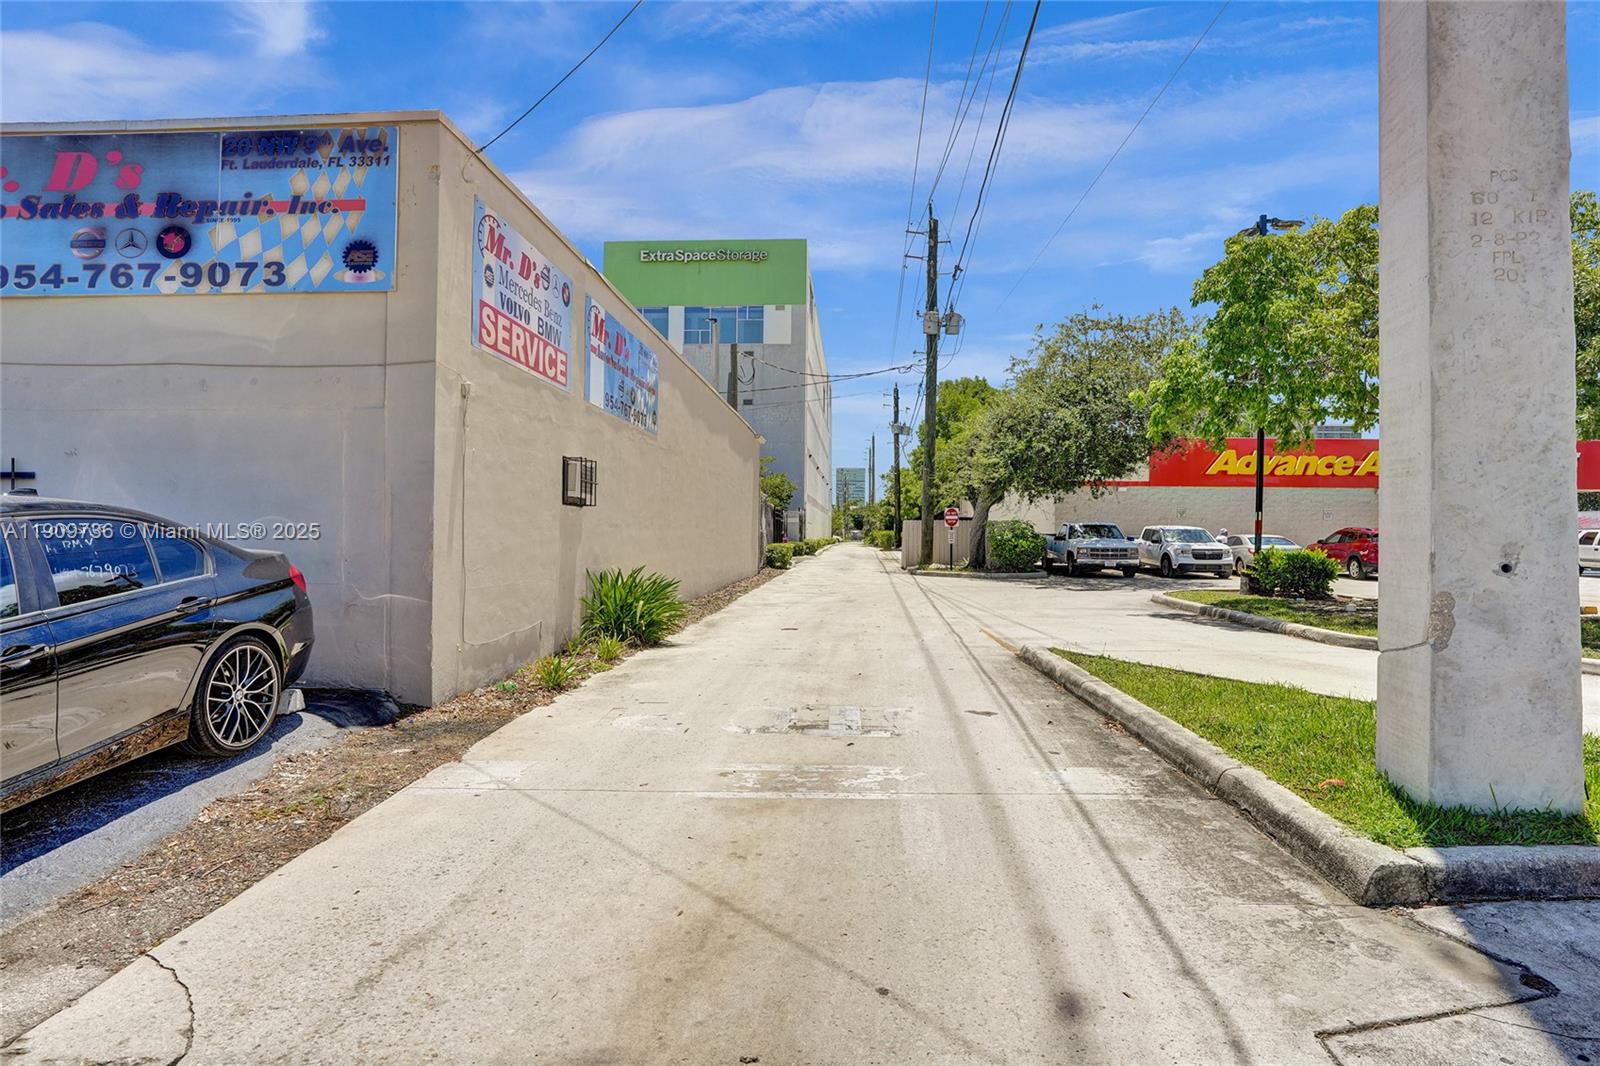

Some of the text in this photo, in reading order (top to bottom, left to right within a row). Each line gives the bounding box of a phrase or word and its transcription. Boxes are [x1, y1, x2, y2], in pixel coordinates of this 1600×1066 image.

[339, 135, 389, 153] Ave.
[42, 150, 144, 192] D's
[221, 155, 390, 170] Ft. Lauderdale, FL 33311
[1490, 169, 1519, 182] PCS
[17, 195, 105, 219] Sales
[115, 193, 143, 218] &
[288, 195, 339, 214] Inc.
[485, 224, 514, 270] Mr.
[499, 264, 542, 312] Mercedes
[499, 291, 562, 348] VOLVO BMW
[481, 306, 567, 384] SERVICE
[1206, 449, 1355, 476] Advance
